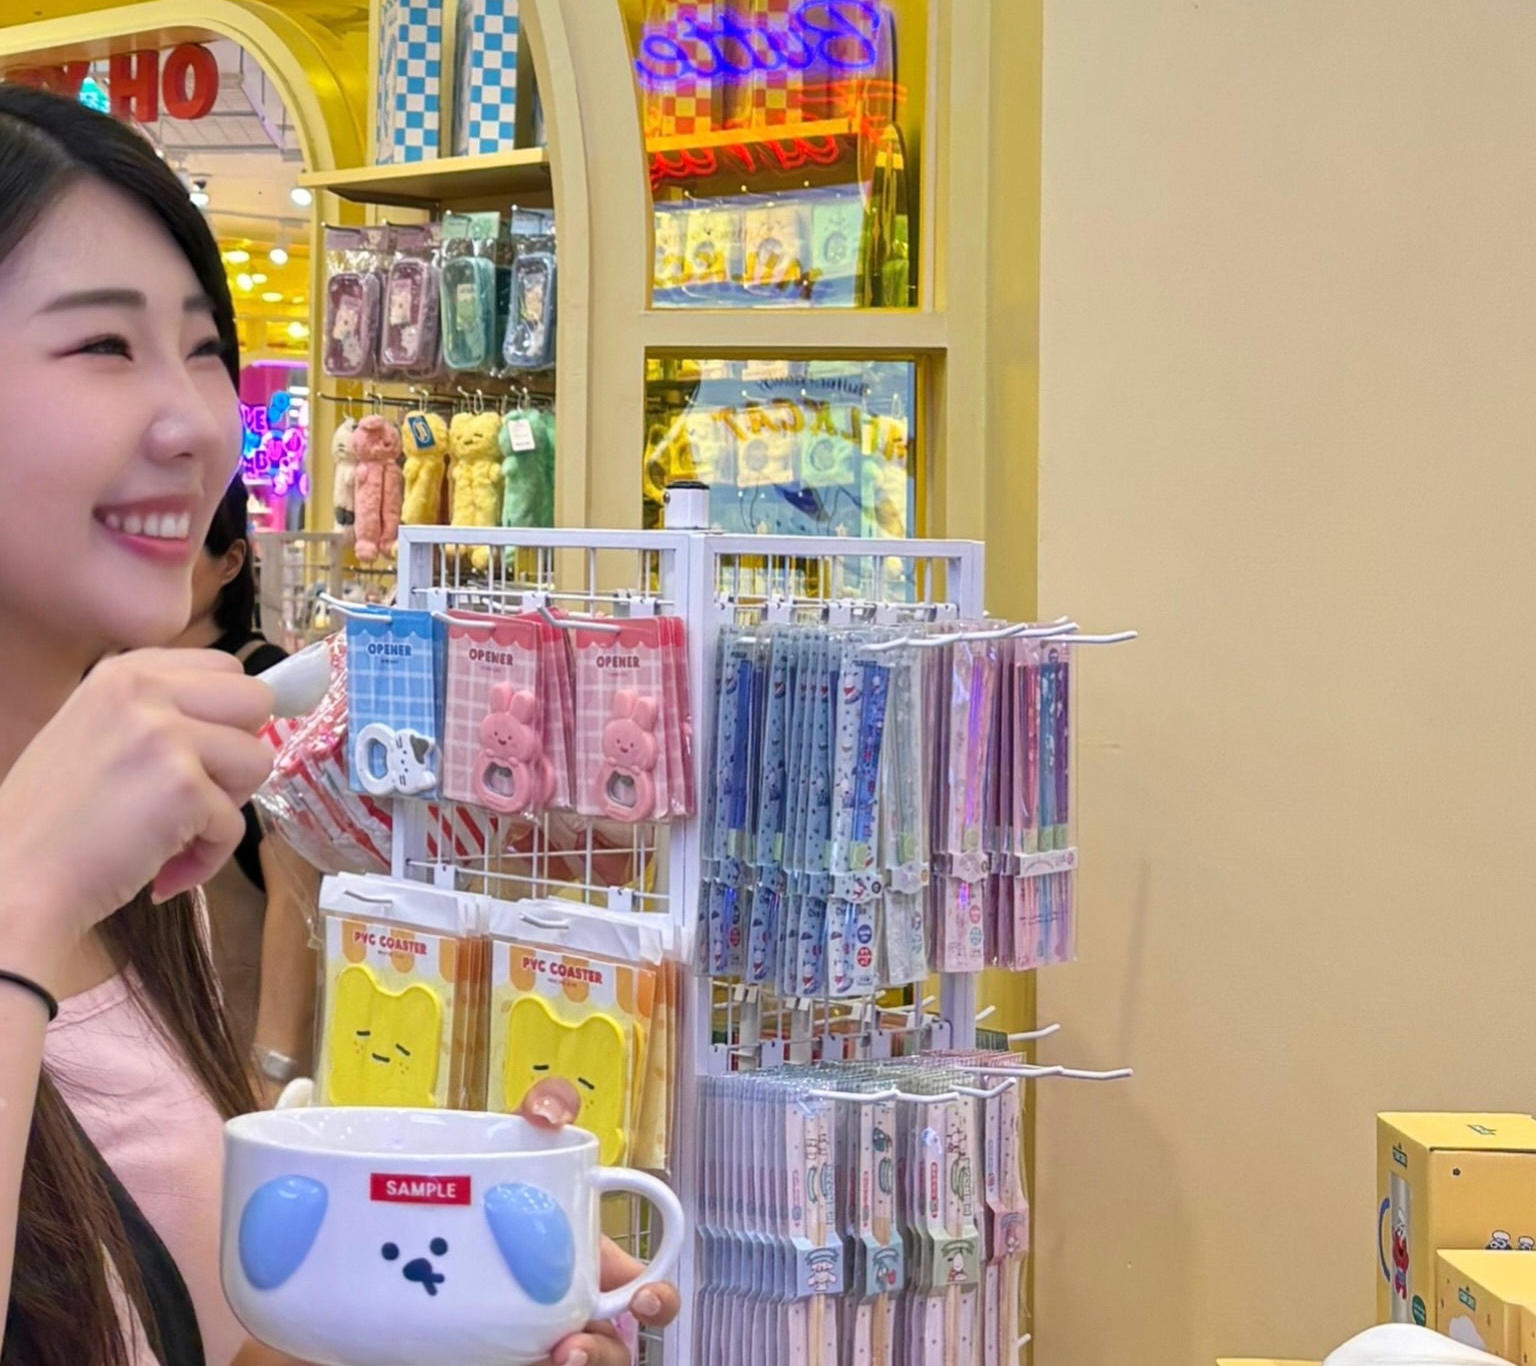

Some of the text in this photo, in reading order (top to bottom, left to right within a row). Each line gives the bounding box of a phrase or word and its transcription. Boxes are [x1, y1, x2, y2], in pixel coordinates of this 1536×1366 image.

[367, 642, 412, 657] OPENER
[468, 648, 513, 666] OPENER
[596, 654, 640, 669] OPENER
[354, 930, 428, 956] PVC COASTER
[522, 955, 603, 985] PVC COASTER
[384, 1179, 457, 1199] SAMPLE
